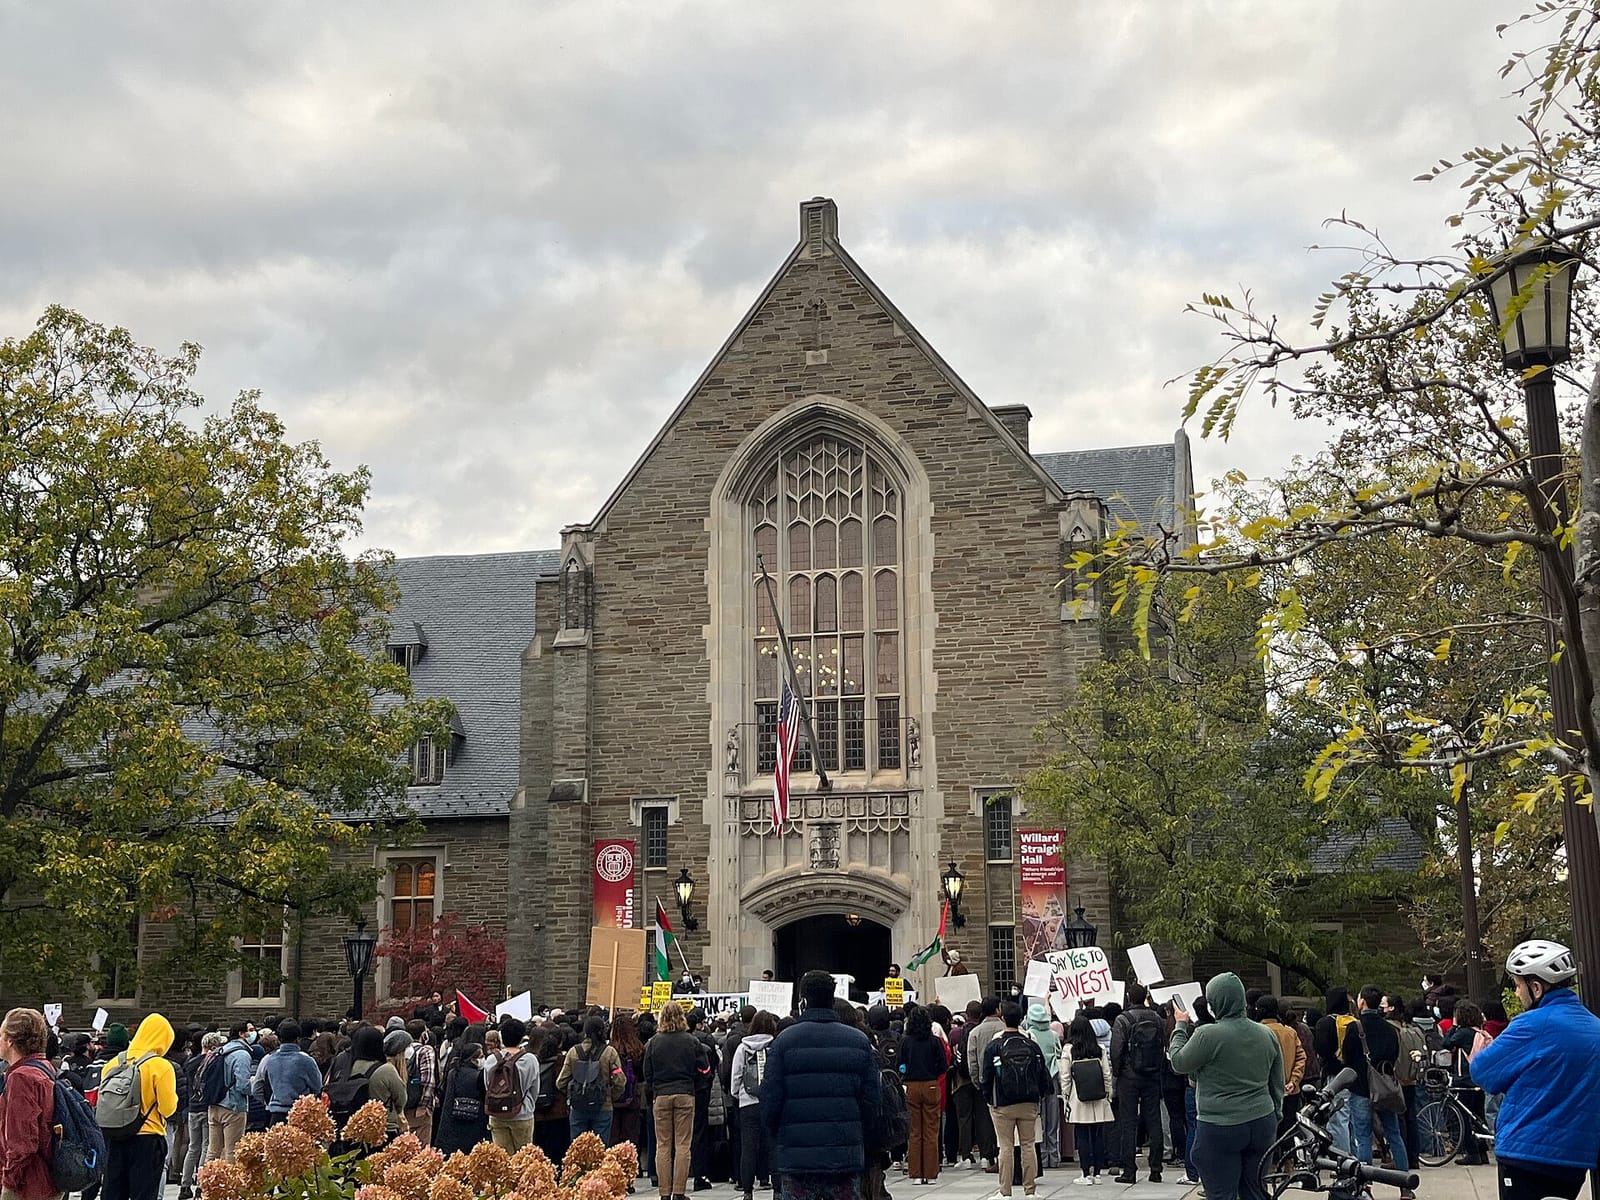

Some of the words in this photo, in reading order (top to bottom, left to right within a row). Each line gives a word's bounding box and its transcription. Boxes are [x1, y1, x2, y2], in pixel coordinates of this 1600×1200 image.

[1020, 833, 1059, 843] Willard
[1021, 855, 1043, 865] Hall
[623, 889, 633, 929] Union
[1049, 955, 1067, 974] SAY
[1066, 951, 1088, 970] YES
[1087, 950, 1103, 963] TO
[1056, 968, 1110, 1000] DIVEST
[730, 1001, 738, 1009] IS
